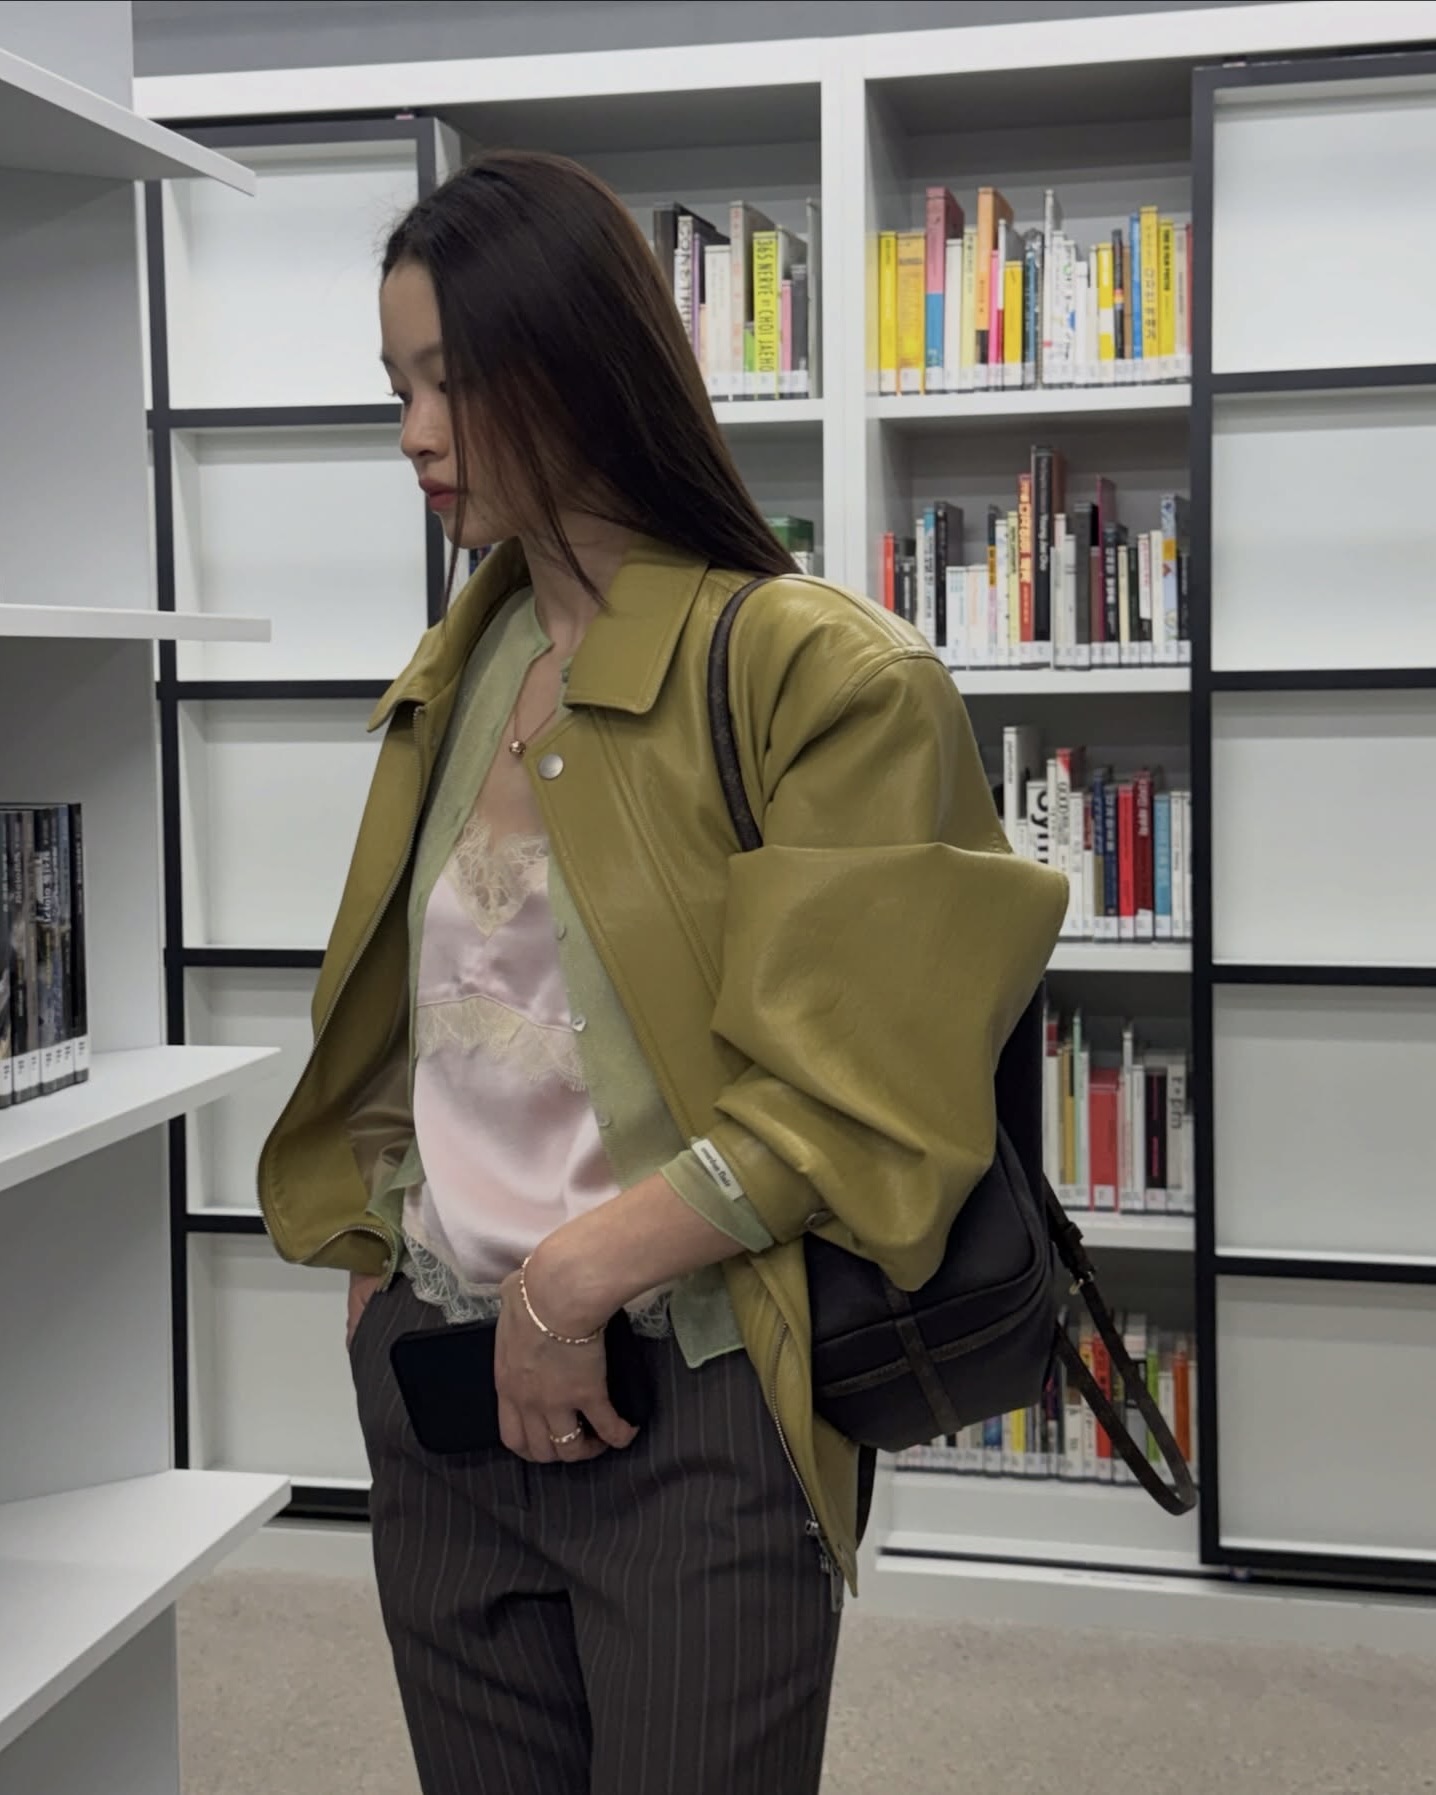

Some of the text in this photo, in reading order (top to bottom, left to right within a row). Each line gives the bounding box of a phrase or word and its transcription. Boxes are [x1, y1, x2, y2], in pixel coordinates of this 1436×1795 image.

[757, 240, 774, 260] 365
[758, 263, 774, 296] NERVE
[758, 309, 774, 335] CHOI
[758, 339, 775, 372] JAEHO
